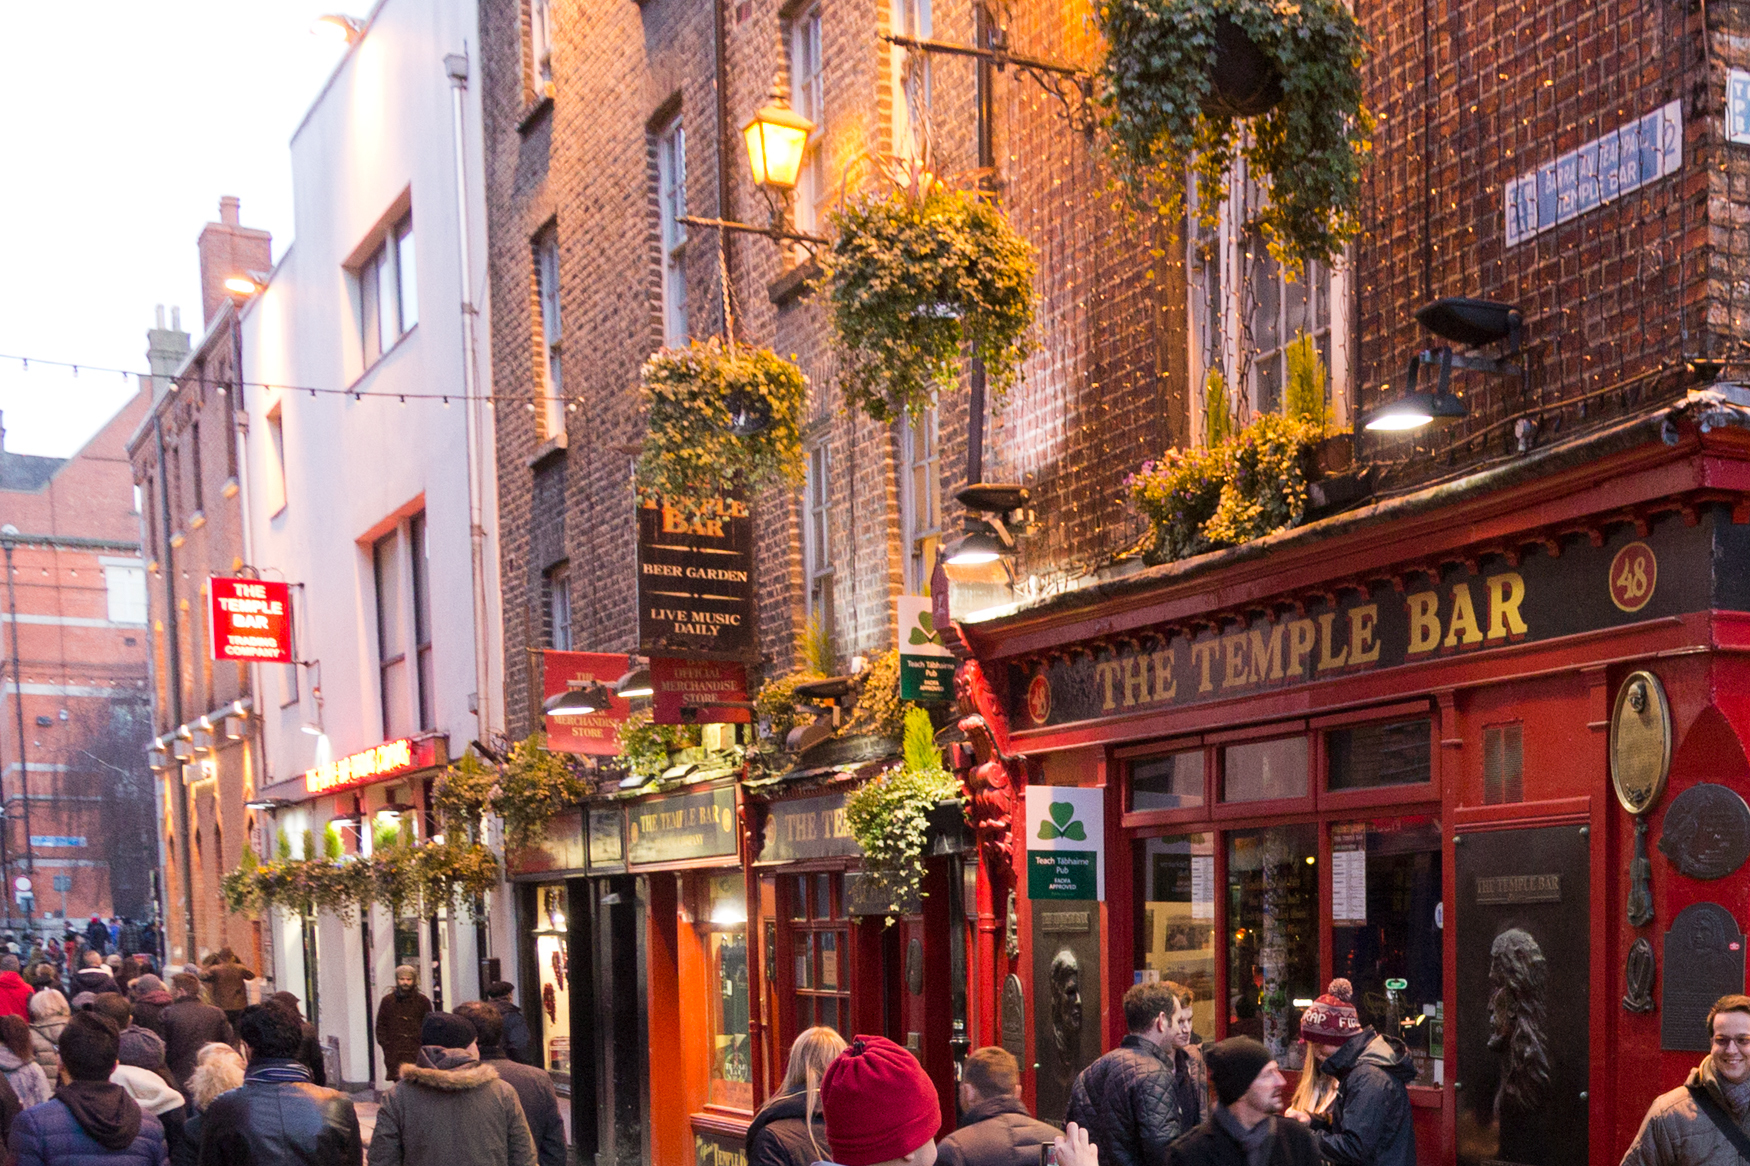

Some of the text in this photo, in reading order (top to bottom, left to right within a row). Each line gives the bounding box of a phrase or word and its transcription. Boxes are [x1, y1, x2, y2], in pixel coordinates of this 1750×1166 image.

[1665, 124, 1677, 157] 2
[1609, 161, 1637, 191] BAR
[662, 508, 725, 537] BAR
[643, 563, 748, 583] BEER GARDEN
[1616, 558, 1648, 599] 48
[233, 583, 267, 599] THE
[218, 597, 284, 615] TEMPLE
[232, 613, 269, 630] BAR
[650, 608, 742, 626] LIVE MUSIC
[674, 622, 721, 637] DAILY
[1096, 572, 1529, 710] THE TEMPLE BAR
[908, 660, 925, 669] Teach
[925, 669, 938, 678] Pub
[660, 680, 739, 692] MERCHANDISE
[571, 726, 604, 739] STORE
[640, 814, 657, 833] THE
[699, 804, 721, 824] BAR
[785, 812, 817, 842] THE
[1036, 857, 1056, 865] Teach
[1056, 866, 1070, 875] Pub
[1538, 876, 1559, 890] BAR
